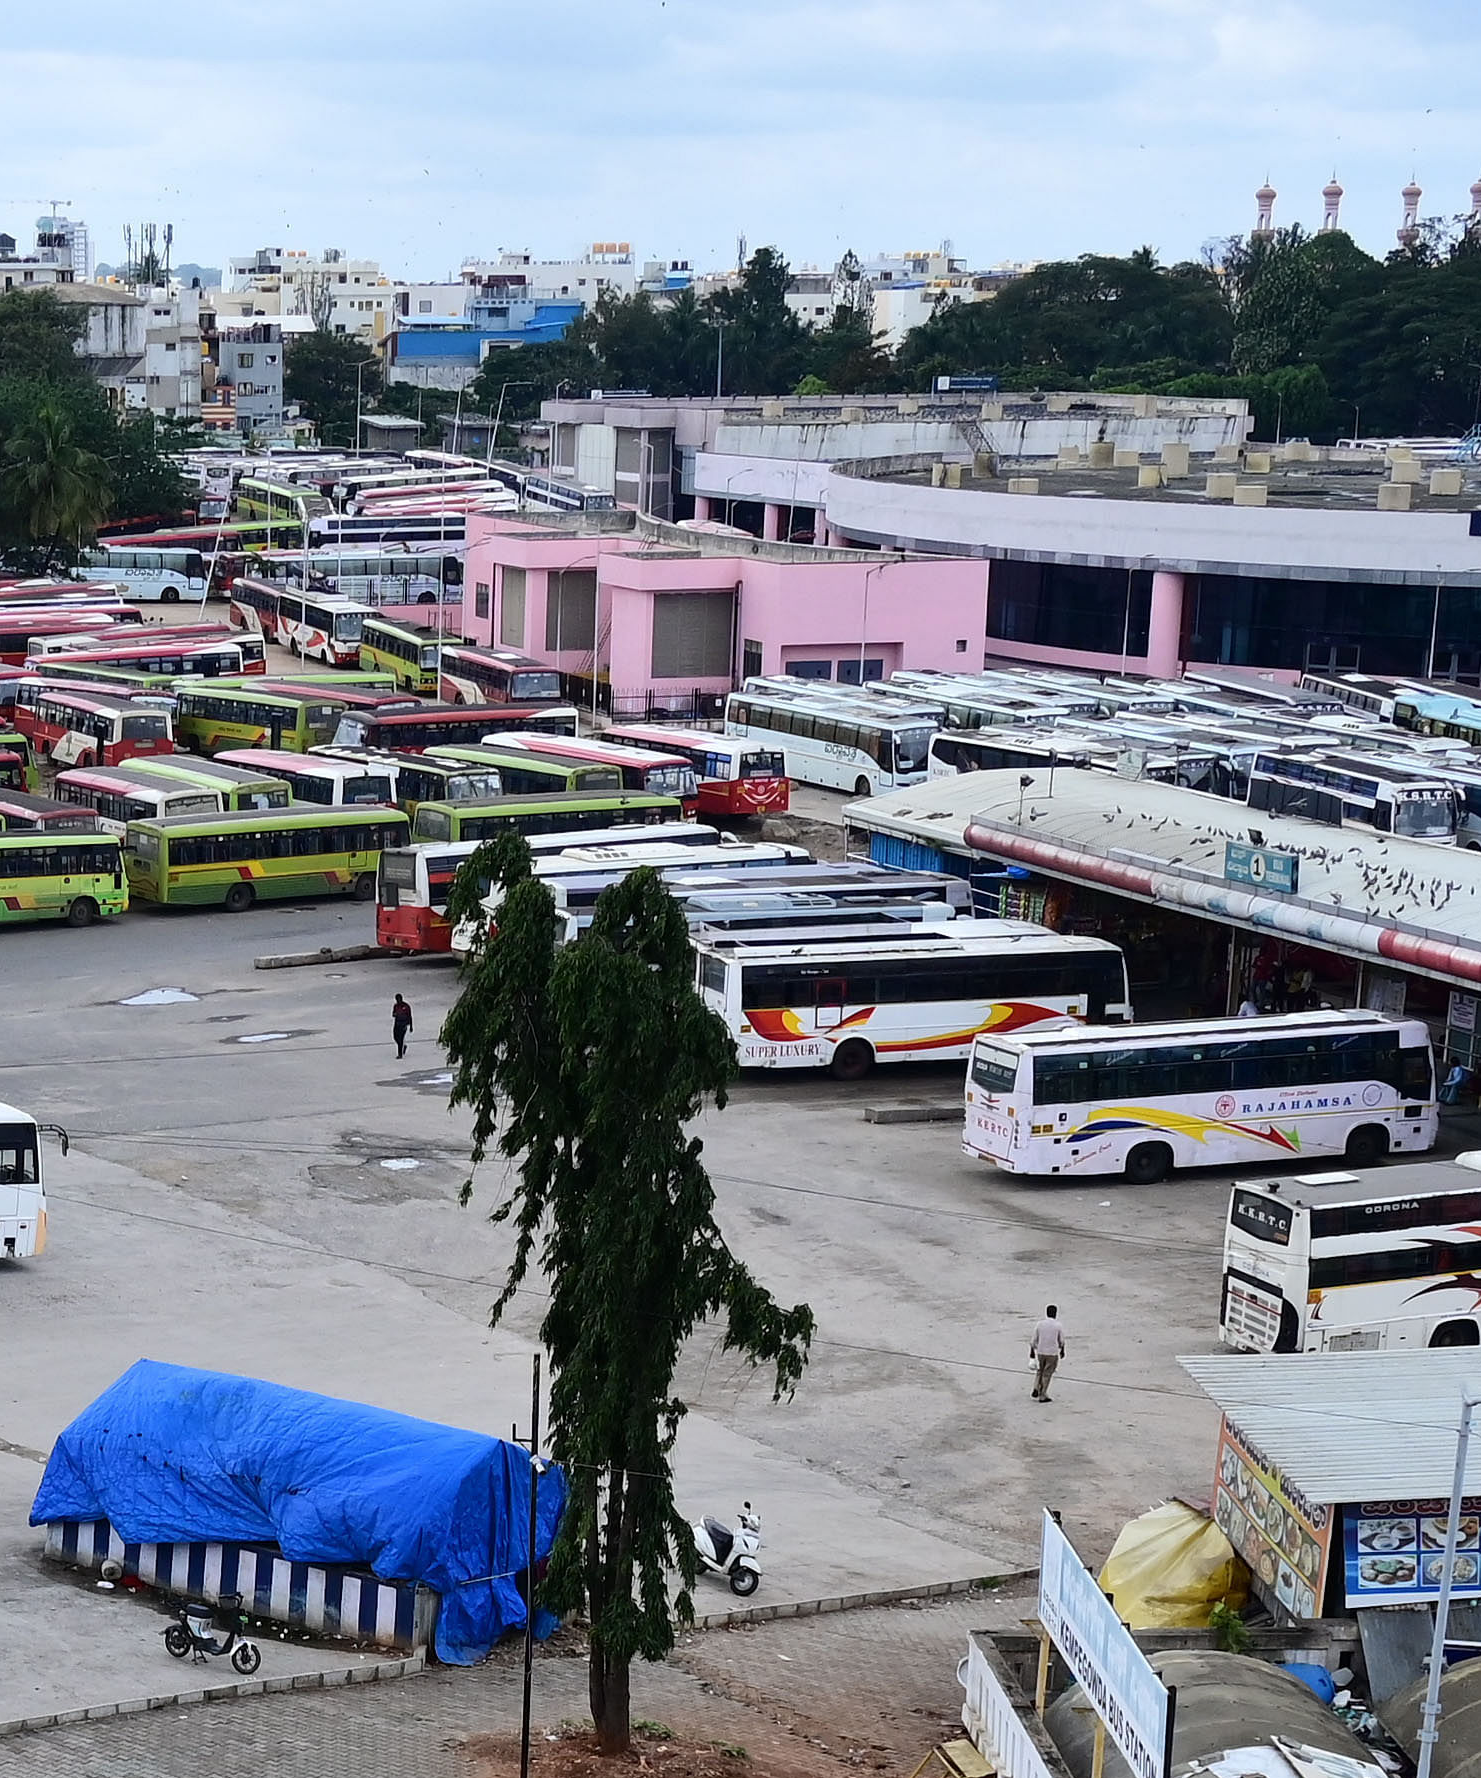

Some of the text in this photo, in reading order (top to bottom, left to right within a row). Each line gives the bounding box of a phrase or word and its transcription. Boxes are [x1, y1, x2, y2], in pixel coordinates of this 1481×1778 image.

[1253, 857, 1261, 876] 1
[745, 1043, 822, 1059] SUPER LUXURY
[1242, 1096, 1353, 1113] RAJAHAMSA
[1364, 1201, 1420, 1214] CORONA
[1060, 1615, 1108, 1718] KEMPEGOWDA
[1108, 1694, 1124, 1740] BUS
